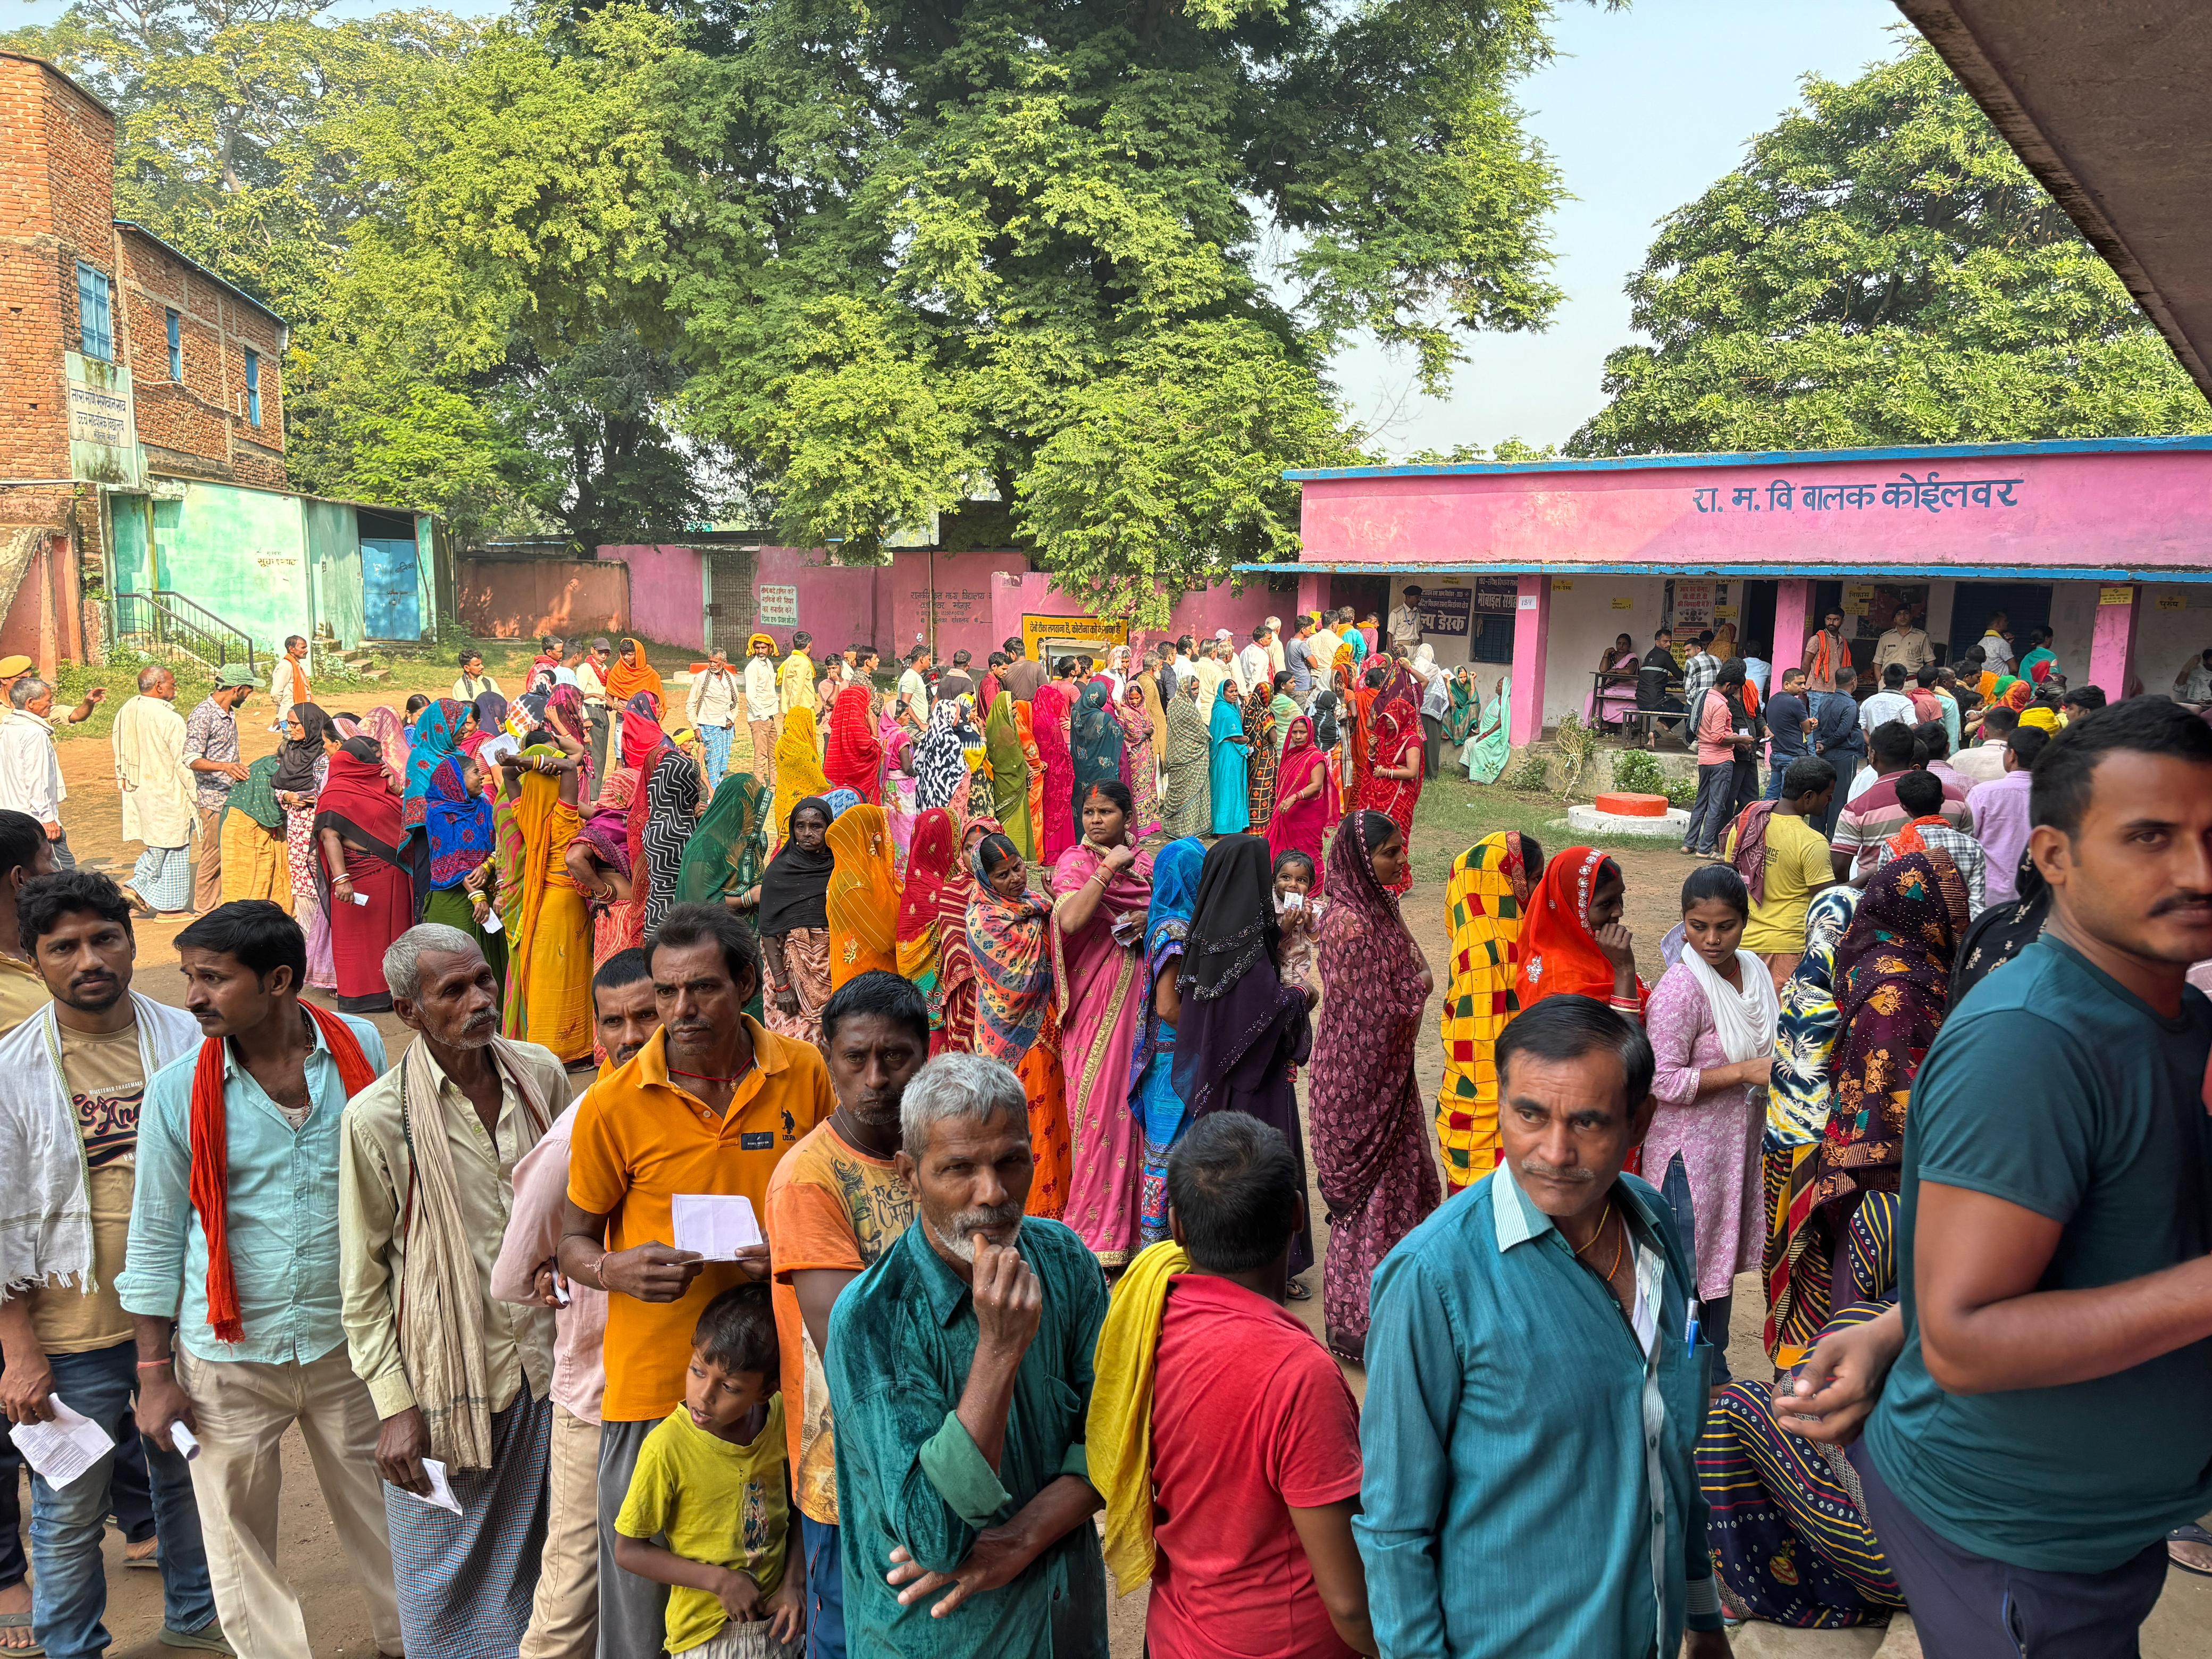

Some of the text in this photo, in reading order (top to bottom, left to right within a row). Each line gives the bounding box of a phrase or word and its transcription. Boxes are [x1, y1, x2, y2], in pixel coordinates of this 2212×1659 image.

[77, 411, 88, 425] उच्च
[107, 414, 124, 432] विद्यालय
[1692, 472, 2025, 513] रा. म. वि बालक कोईलवर
[1497, 577, 1510, 586] विधान
[962, 589, 985, 600] विद्यालय
[1478, 589, 1502, 609] मोबाइल
[1428, 599, 1439, 607] विधान
[2159, 600, 2179, 609] पुरुष
[1420, 610, 1467, 632] ल्प डेस्क
[1038, 623, 1047, 633] टीका
[1071, 623, 1090, 634] कोरोना
[1090, 623, 1097, 634] को
[1097, 625, 1116, 634] भगाना
[1765, 846, 1779, 858] ORCE
[115, 1080, 143, 1091] TRADEMARK
